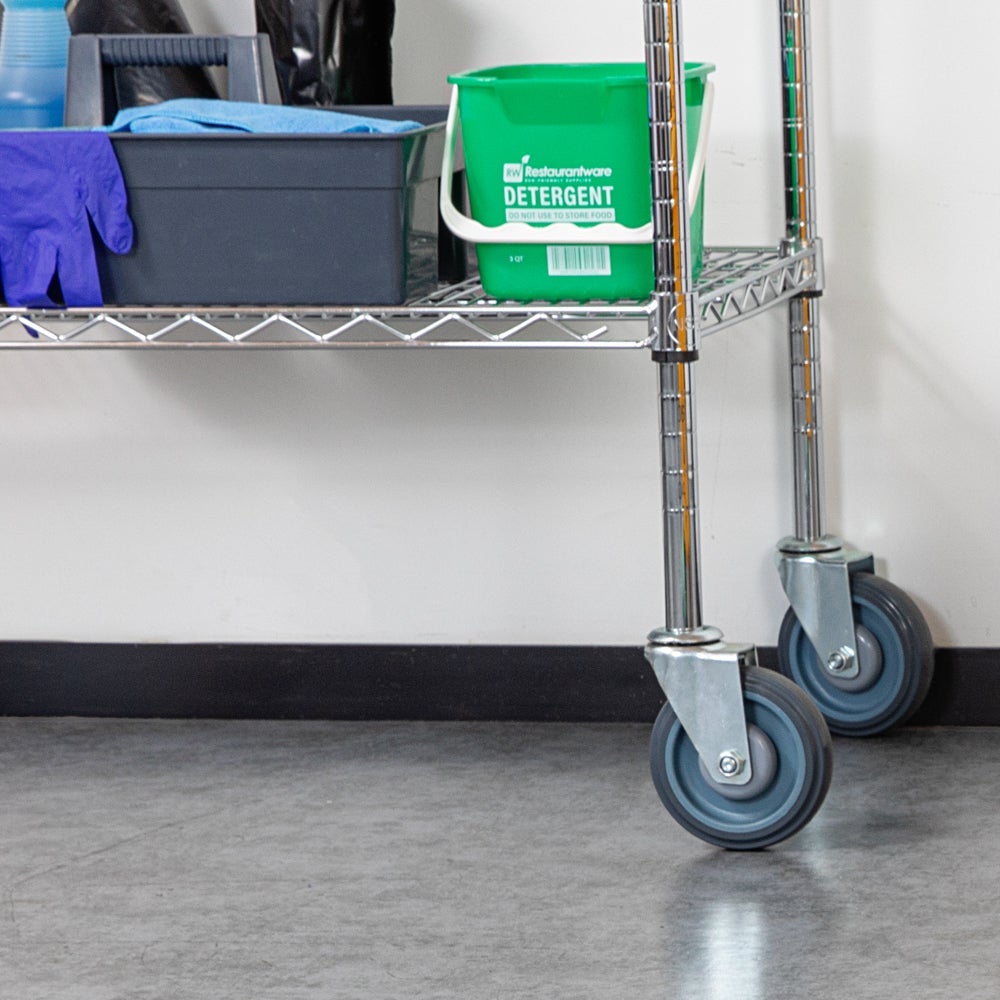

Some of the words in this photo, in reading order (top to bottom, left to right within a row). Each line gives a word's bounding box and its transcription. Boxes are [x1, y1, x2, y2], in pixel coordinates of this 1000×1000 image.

[506, 167, 521, 178] RW
[525, 166, 612, 177] Restaurantware
[504, 186, 613, 206] DETERGENT
[508, 211, 520, 219] DO
[521, 211, 535, 219] NOT
[537, 211, 551, 219] USE
[554, 211, 564, 219] TO
[565, 211, 589, 219] STORE
[591, 211, 613, 219] FOOD
